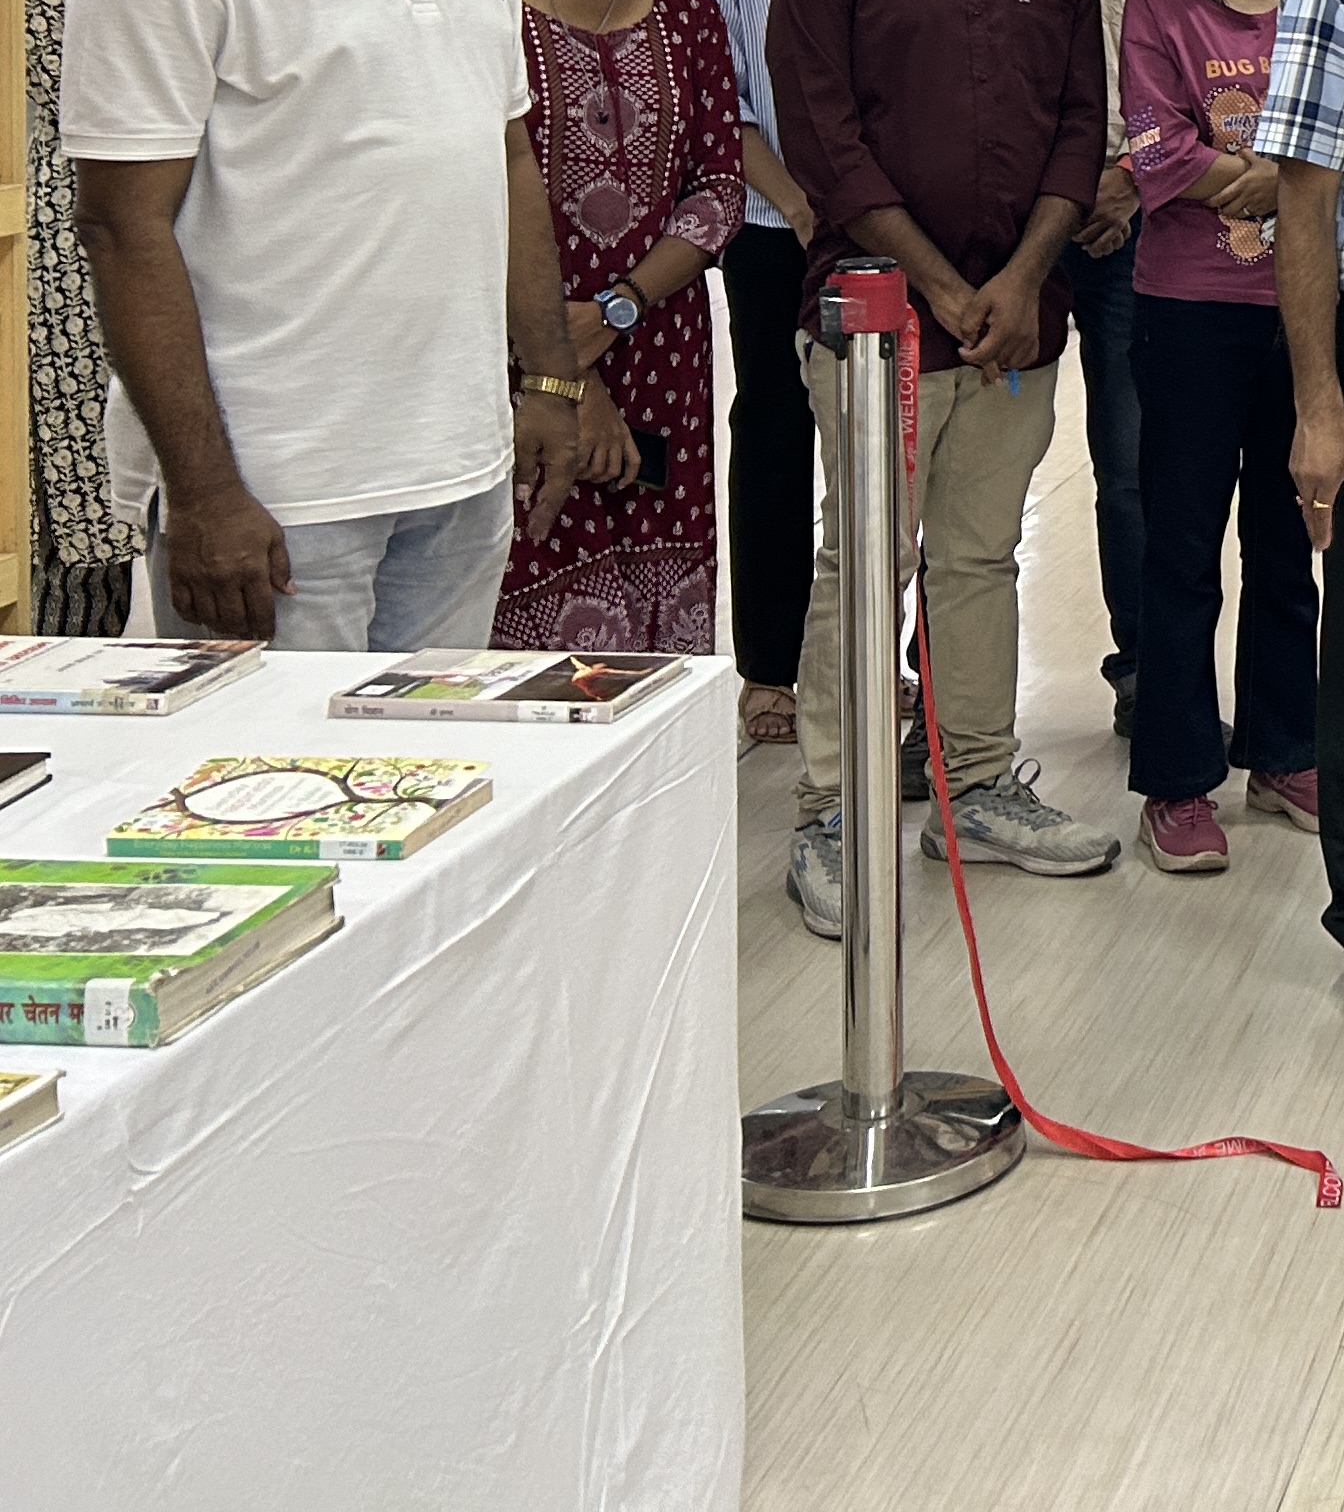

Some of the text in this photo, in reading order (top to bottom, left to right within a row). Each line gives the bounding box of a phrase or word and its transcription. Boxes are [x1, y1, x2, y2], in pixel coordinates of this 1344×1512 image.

[1205, 58, 1255, 79] BUG
[899, 342, 915, 434] WELCOME
[21, 994, 61, 1025] चेतन
